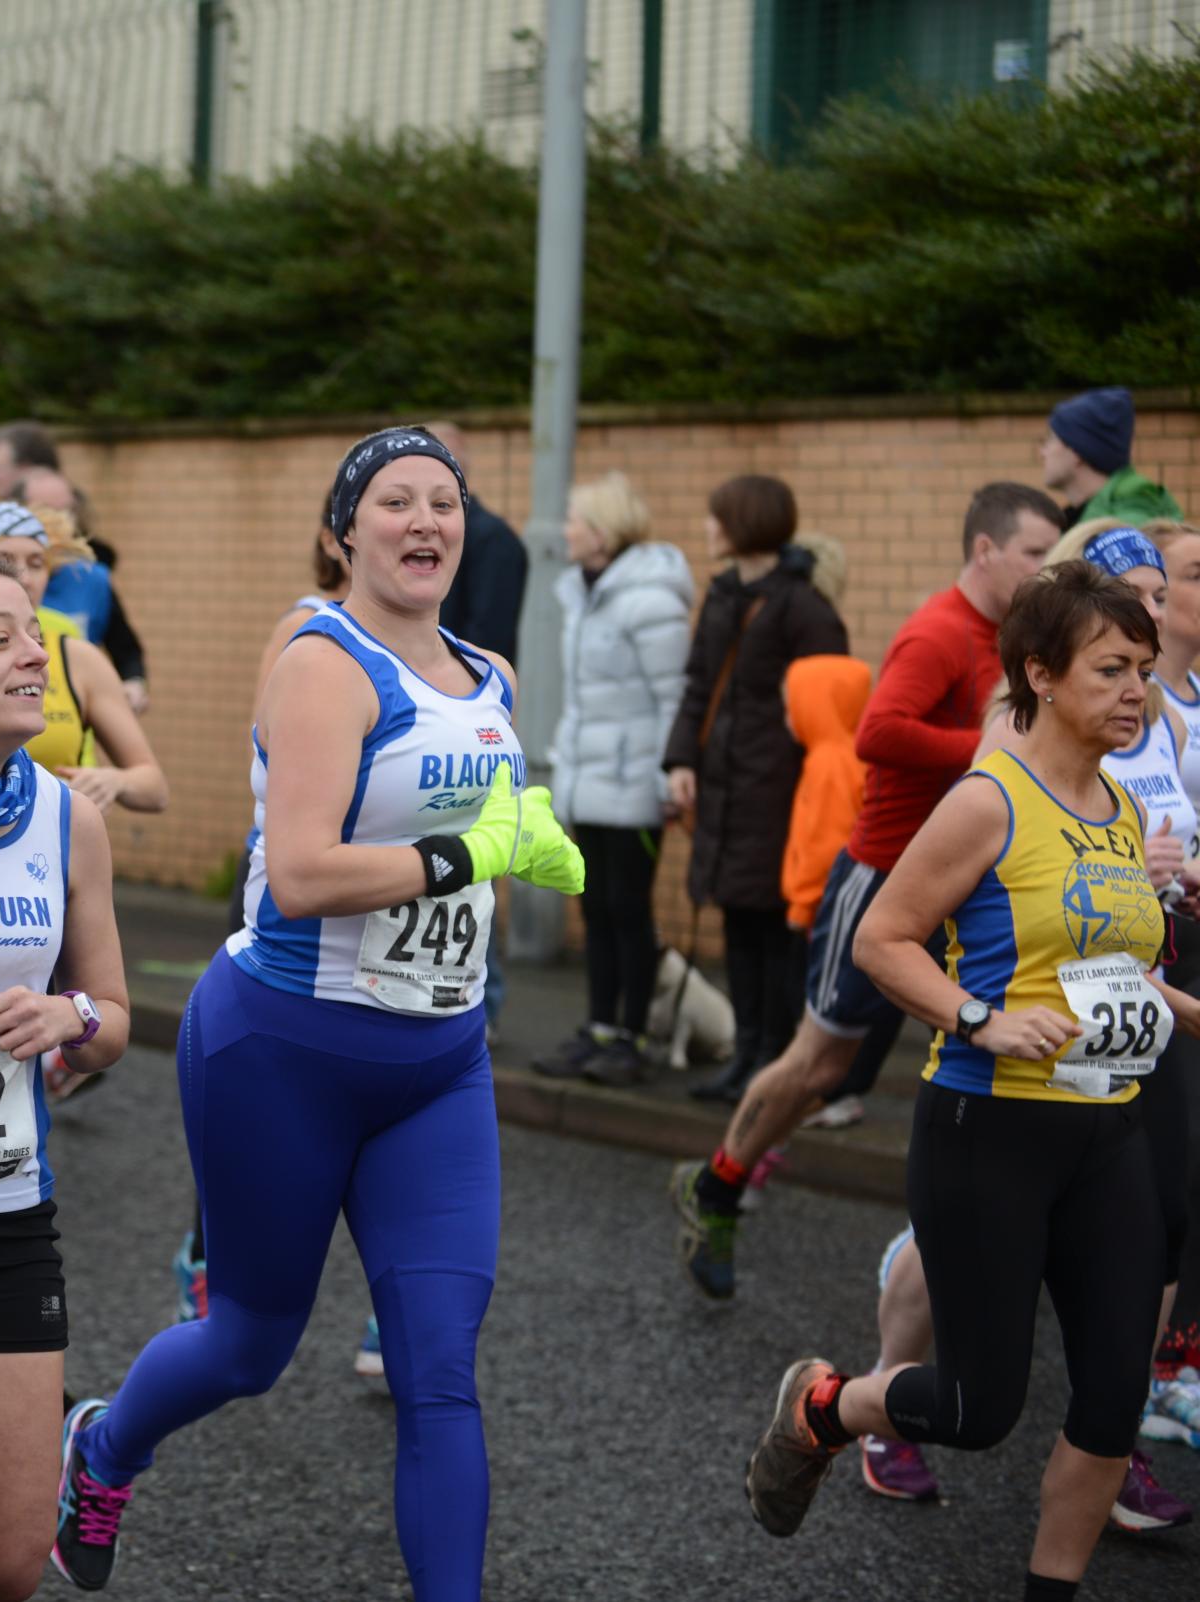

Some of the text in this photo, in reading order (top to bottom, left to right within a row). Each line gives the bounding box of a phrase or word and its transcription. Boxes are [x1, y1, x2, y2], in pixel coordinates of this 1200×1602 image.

[1060, 822, 1144, 870] ALEX
[384, 900, 478, 967] 249
[1087, 966, 1139, 980] LANCASHIRE
[1107, 981, 1141, 993] 10K 2016
[1085, 1001, 1159, 1057] 358
[3, 1146, 30, 1158] BODIES
